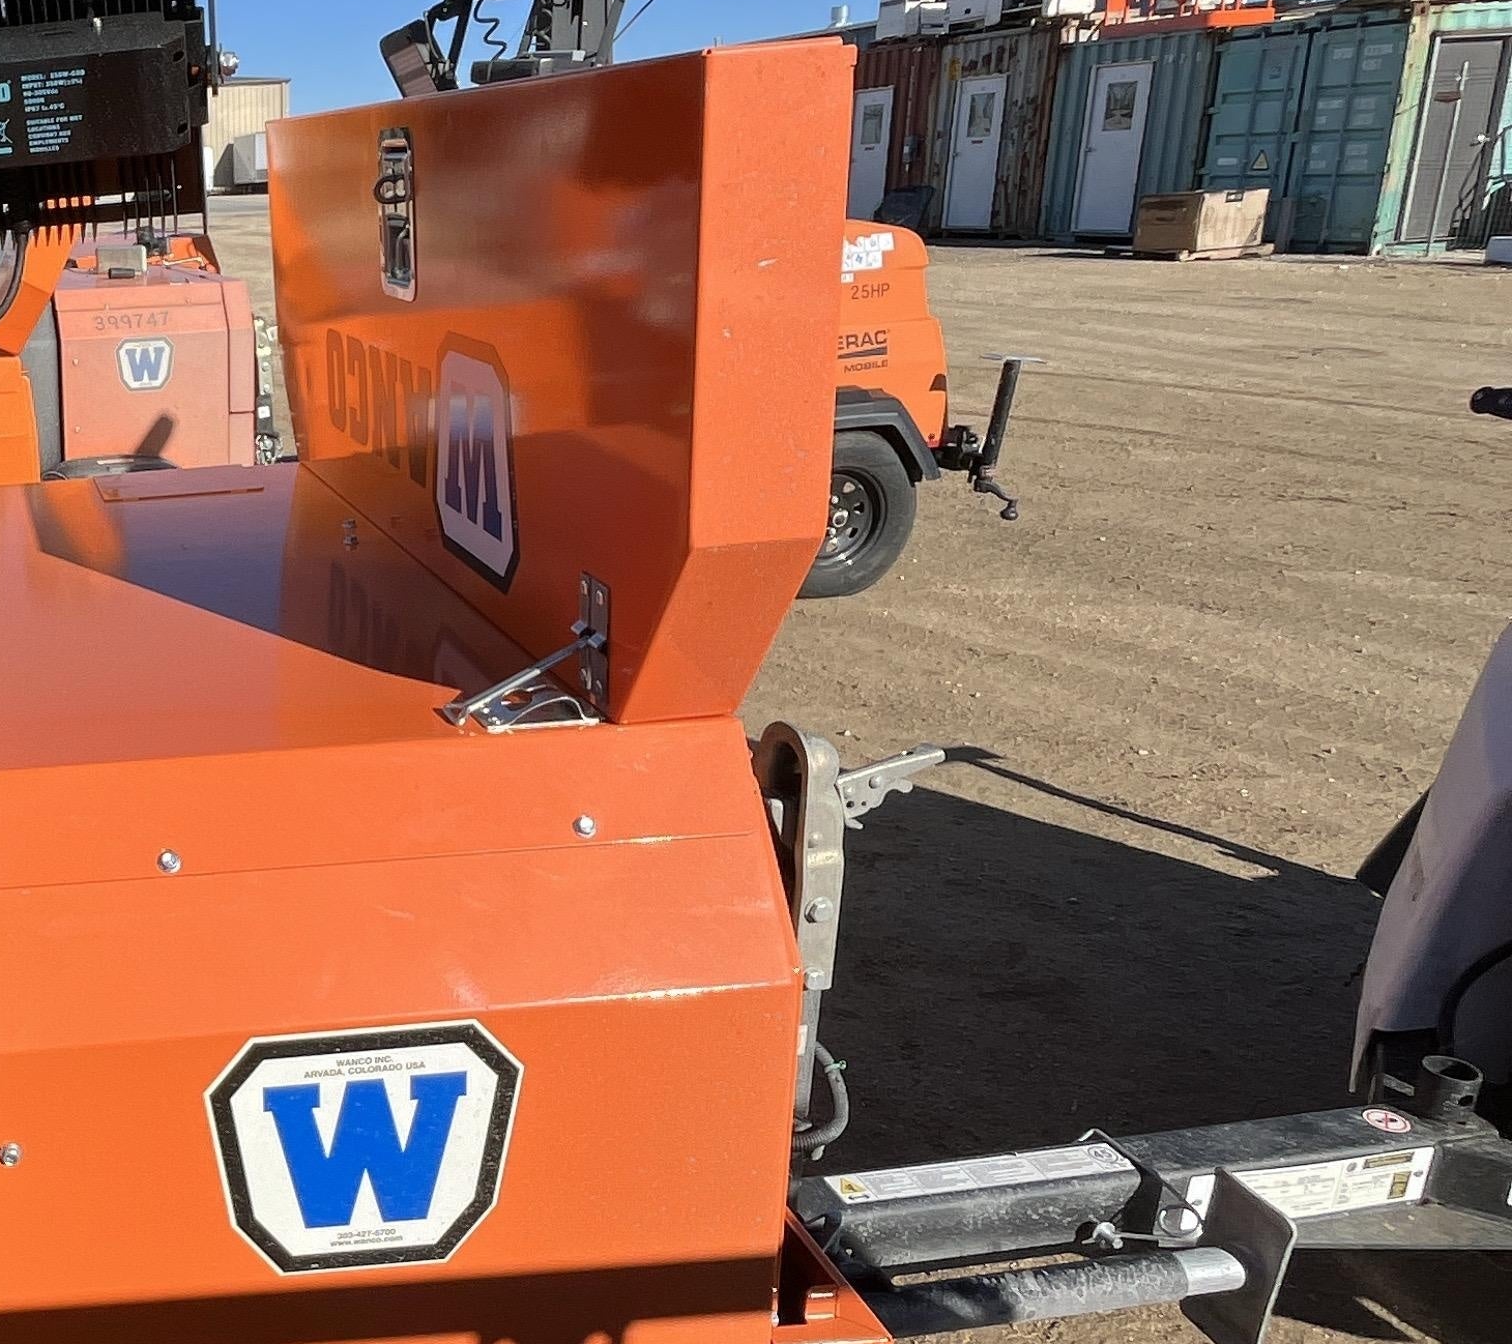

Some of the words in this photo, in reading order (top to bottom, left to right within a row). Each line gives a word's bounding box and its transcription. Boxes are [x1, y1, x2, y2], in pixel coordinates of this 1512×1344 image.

[850, 282, 890, 300] 25HP
[94, 311, 170, 331] 399747
[125, 346, 165, 382] W
[843, 359, 889, 374] MOBILE
[304, 1068, 345, 1079] ARVADA,
[348, 1063, 403, 1075] COLORADO
[406, 1061, 426, 1070] USA
[336, 1056, 372, 1067] WANCO
[374, 1055, 393, 1064] INC.
[263, 1071, 468, 1229] W
